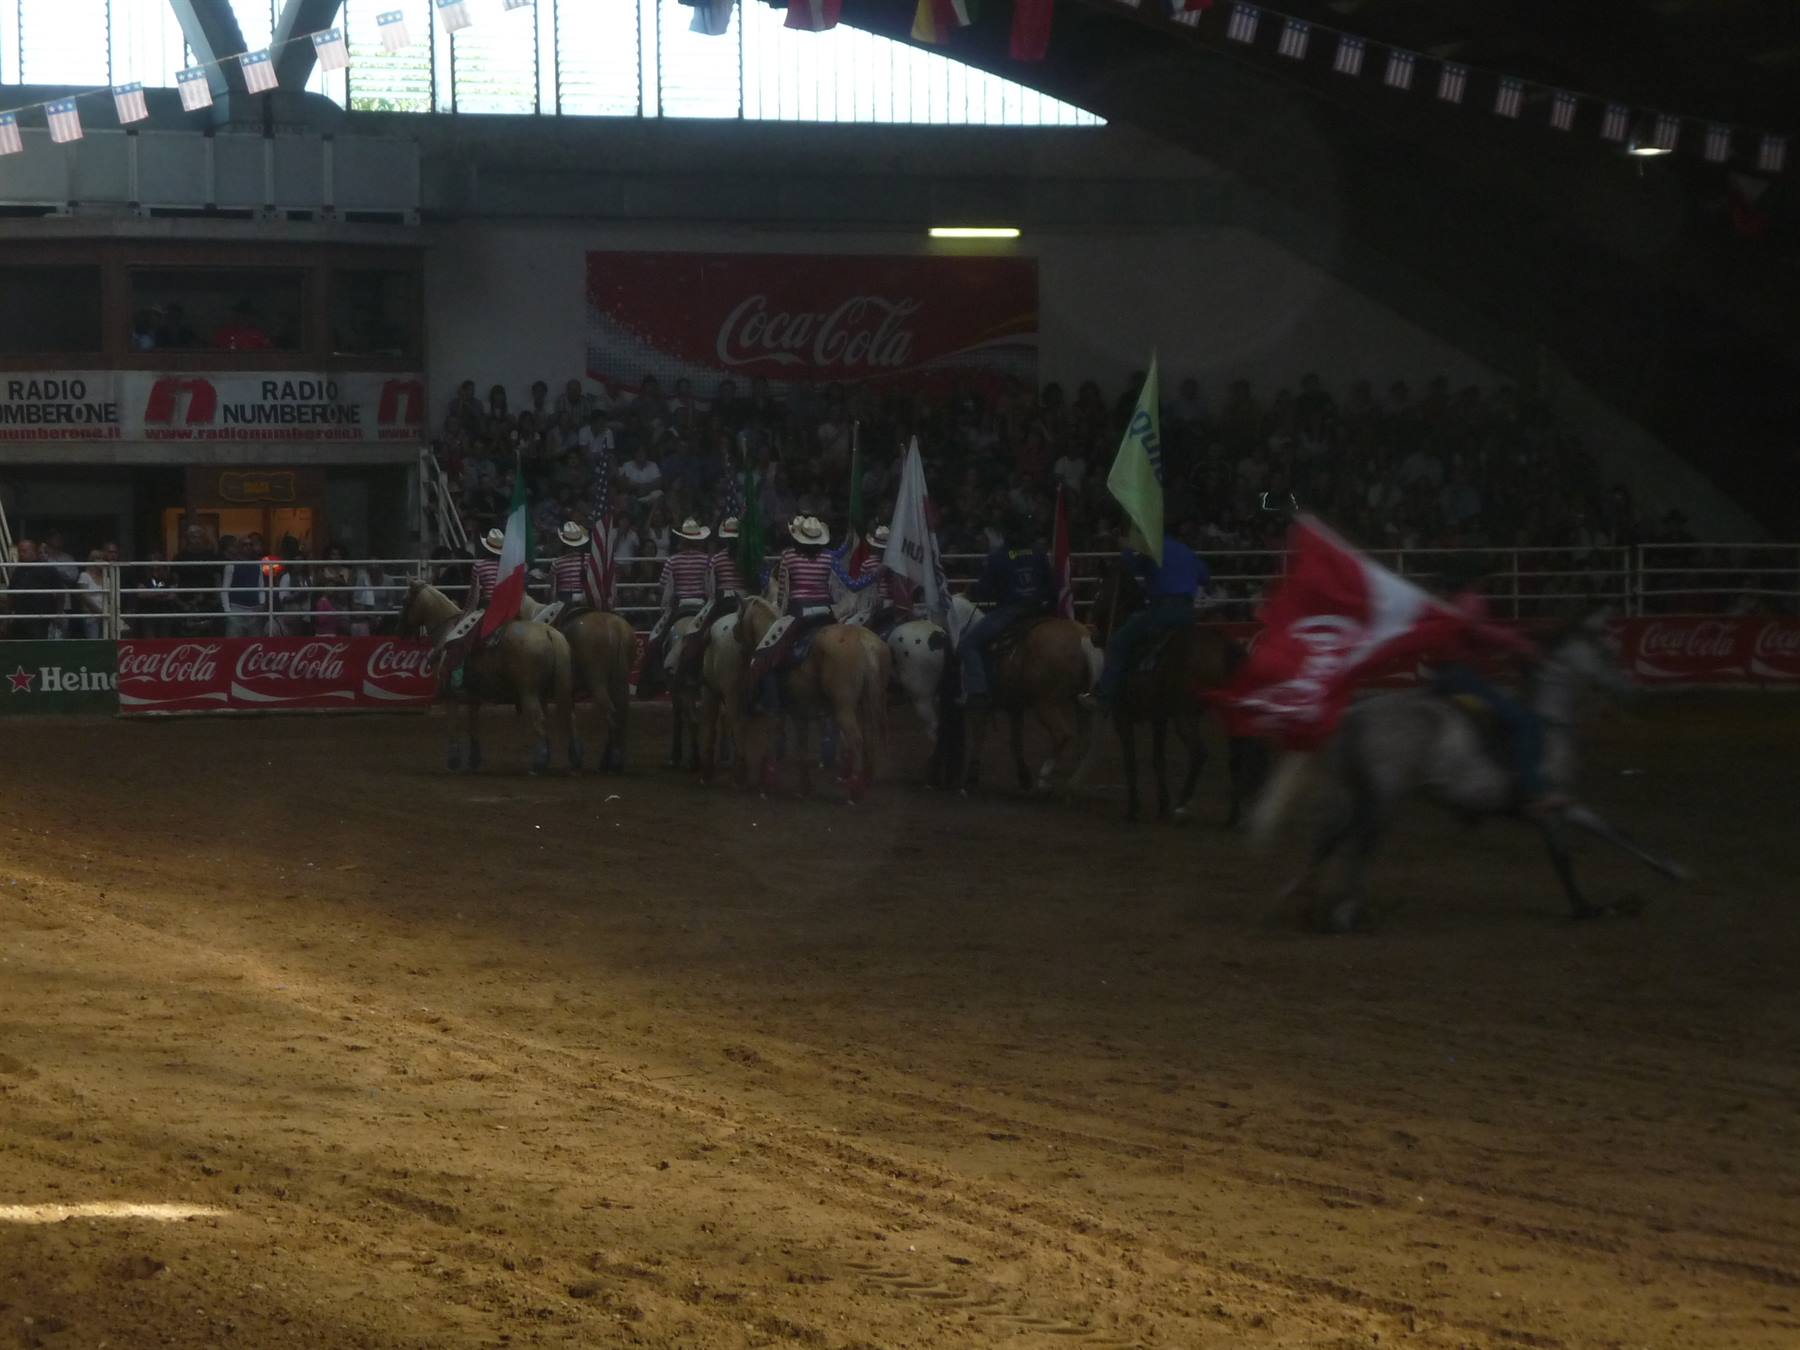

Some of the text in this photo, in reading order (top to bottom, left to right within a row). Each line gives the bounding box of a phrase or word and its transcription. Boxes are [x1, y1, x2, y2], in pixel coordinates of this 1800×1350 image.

[716, 294, 924, 366] Coca-Cola
[8, 379, 87, 401] RADIO
[262, 380, 338, 401] RADIO
[0, 403, 119, 424] MBERONE
[223, 404, 360, 424] NUMBERONE
[1639, 621, 1739, 657] Coca-Cola
[235, 642, 350, 680] Coca-Cola
